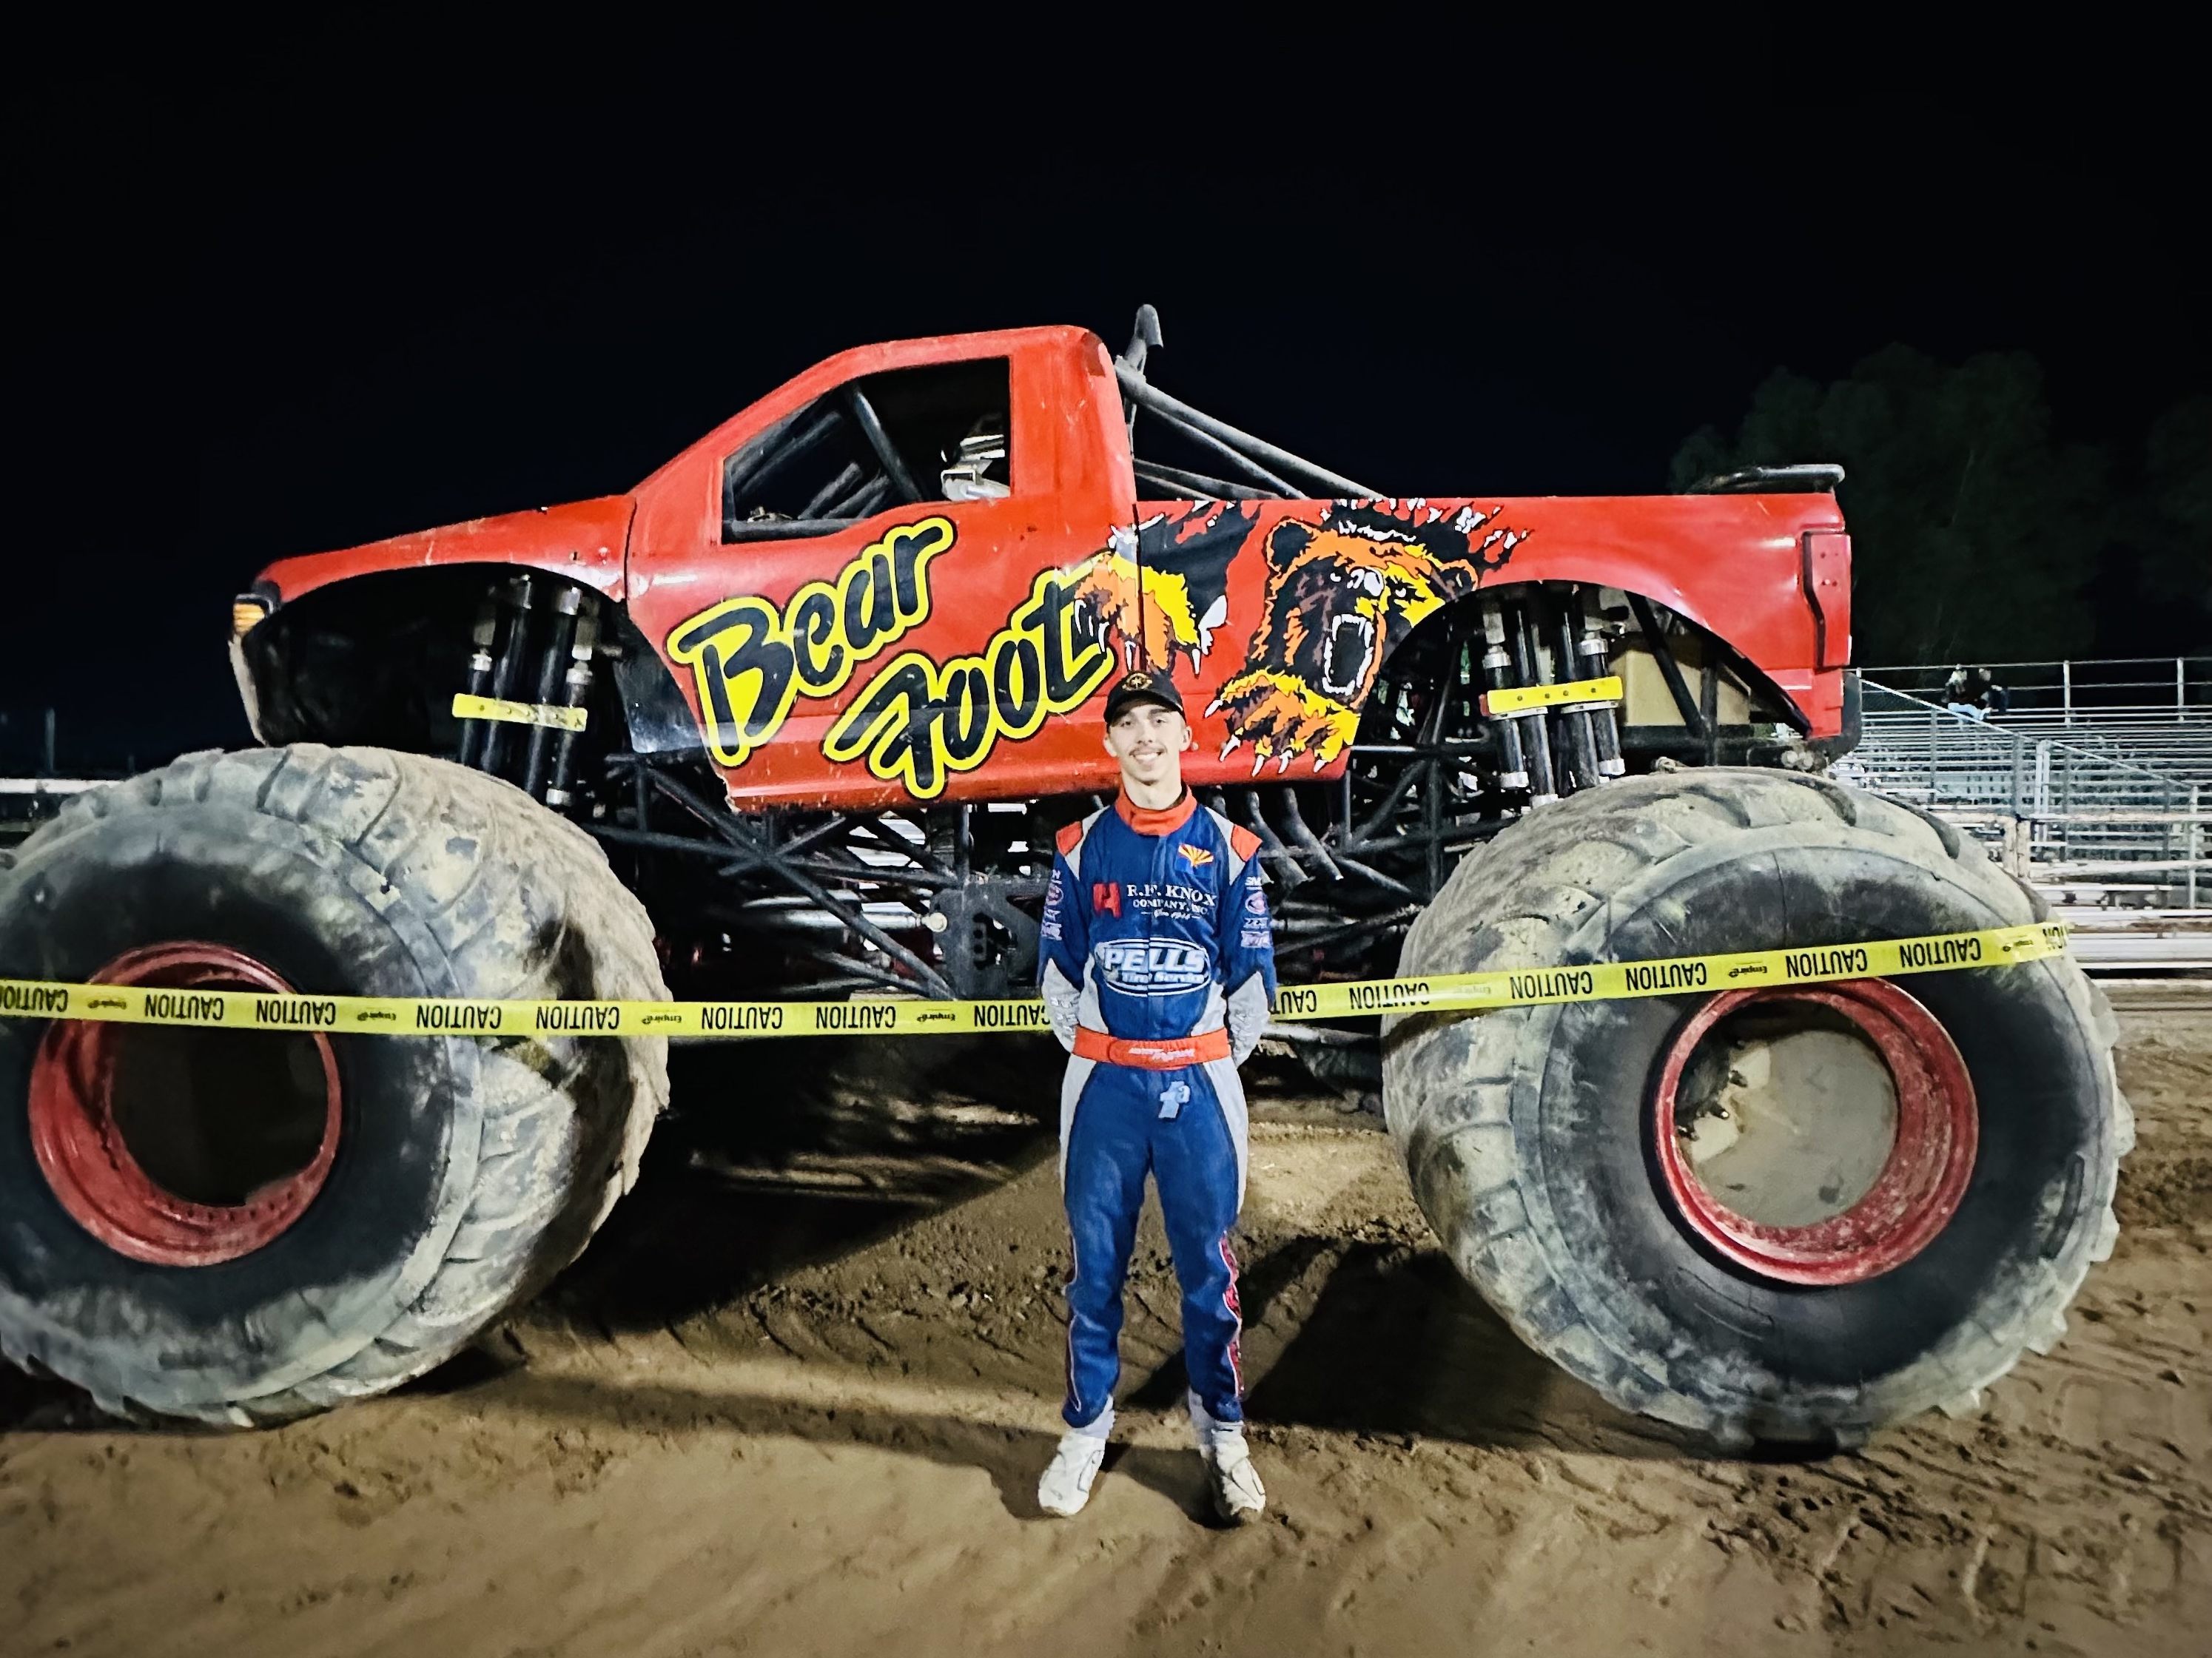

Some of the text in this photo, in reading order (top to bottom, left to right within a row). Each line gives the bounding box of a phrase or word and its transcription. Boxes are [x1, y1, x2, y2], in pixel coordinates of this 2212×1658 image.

[668, 516, 954, 766] Bear
[821, 565, 1114, 798] Foot
[1166, 884, 1217, 906] KNOX
[1104, 948, 1206, 973] PELLS
[1785, 948, 1869, 978] CAUTION
[1899, 937, 1982, 968] CAUTION
[1509, 971, 1593, 1000] CAUTION
[1625, 962, 1707, 991] CAUTION
[0, 985, 69, 1012] CAUTIO
[144, 994, 224, 1020] CAUTION
[1270, 990, 1317, 1015] CAUT
[1350, 982, 1431, 1010] CAUTION
[256, 999, 336, 1026] CAUTION
[416, 1005, 502, 1029] CAUTION
[536, 1005, 620, 1030] CAUTION
[702, 1006, 783, 1030] CAUTION
[816, 1005, 896, 1029] CAUTION
